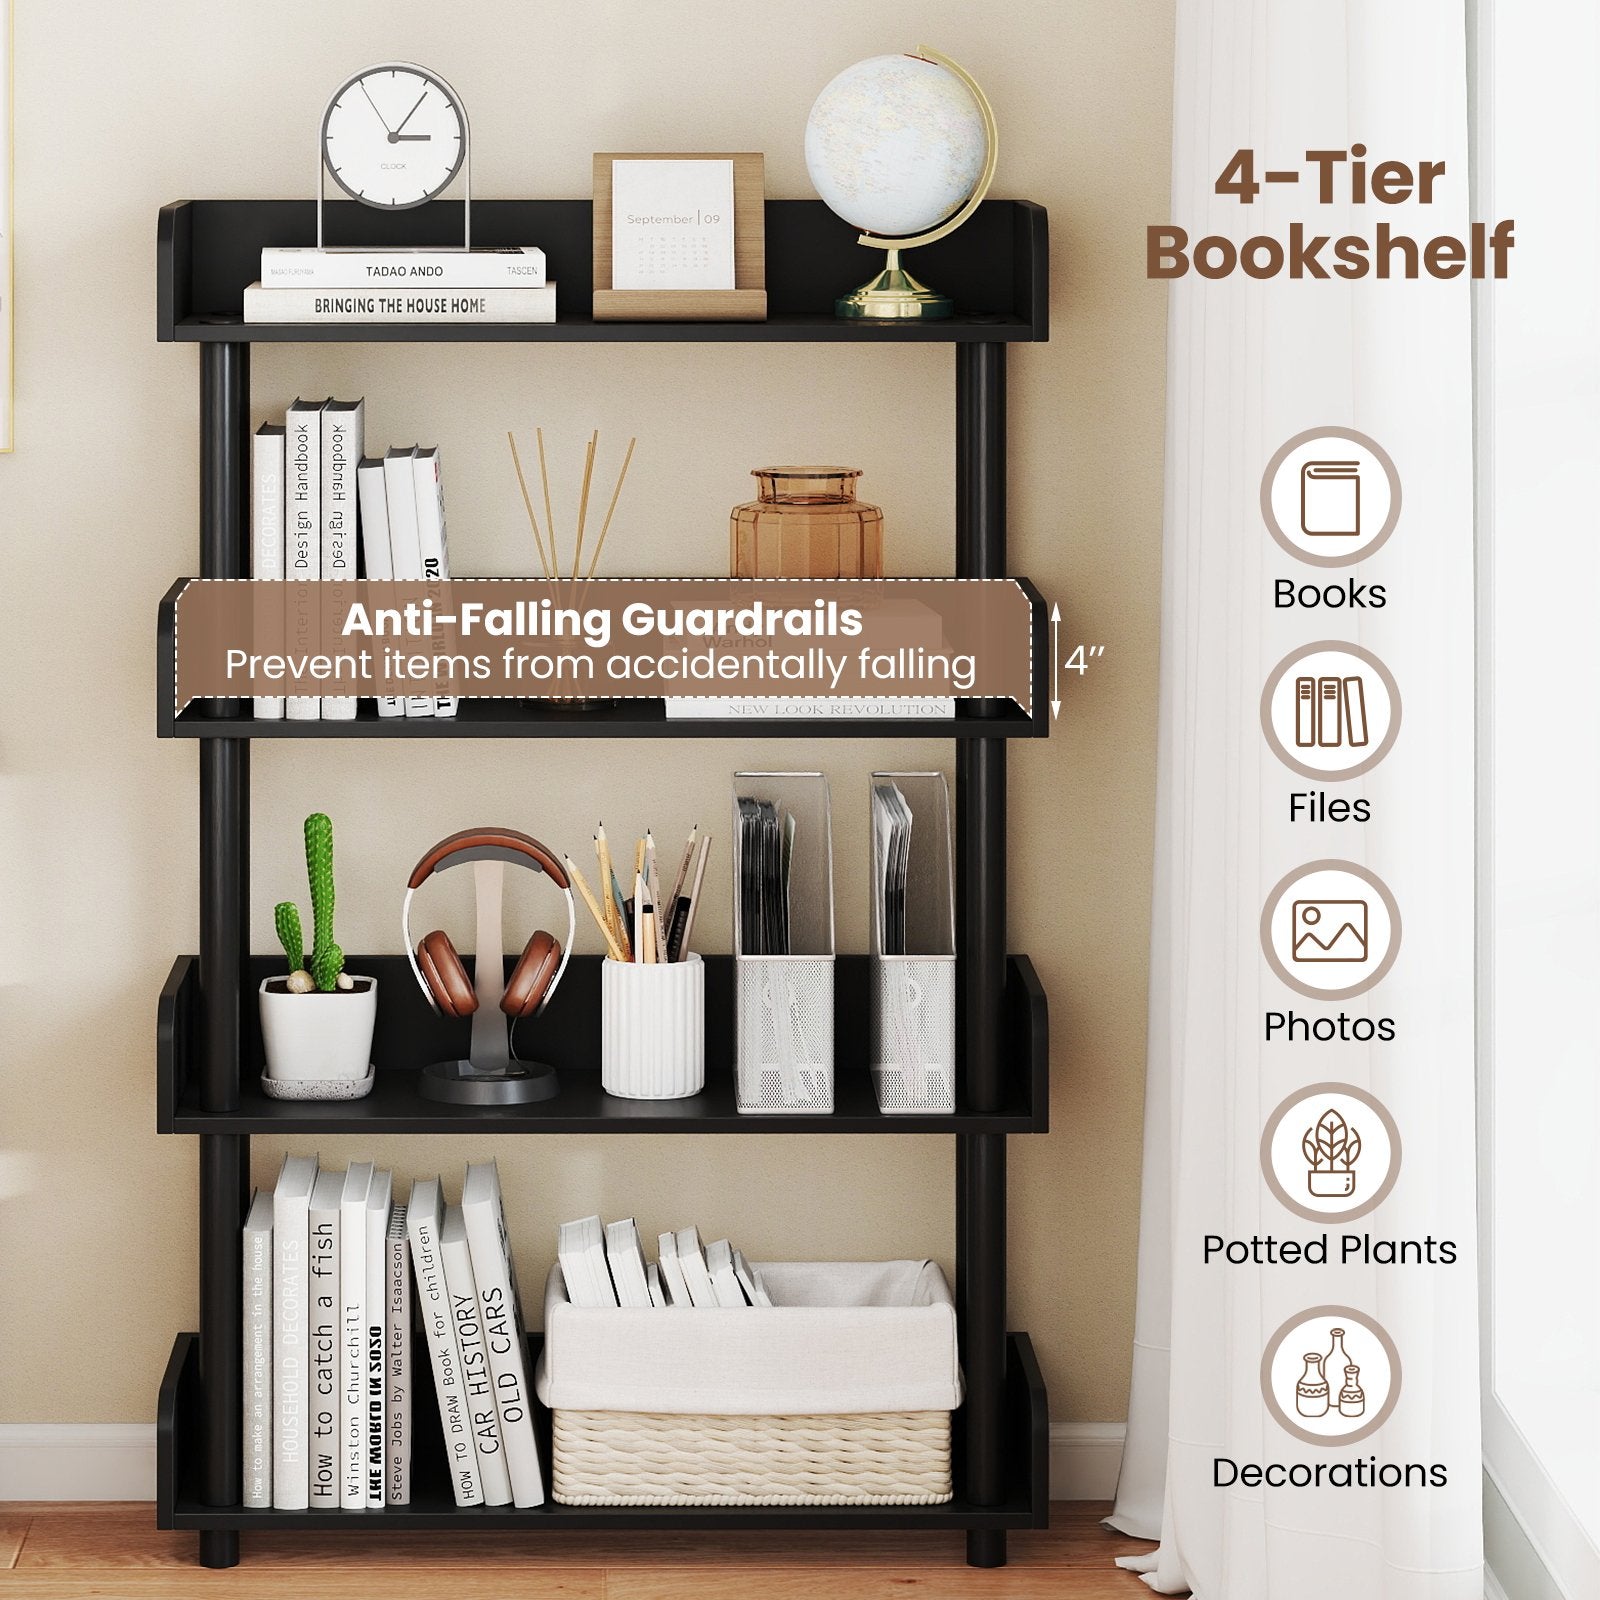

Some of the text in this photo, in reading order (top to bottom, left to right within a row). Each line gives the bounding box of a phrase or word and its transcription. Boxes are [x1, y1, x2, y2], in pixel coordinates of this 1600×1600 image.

[365, 266, 444, 277] TADAO ANDO
[626, 214, 721, 226] September 09
[314, 298, 486, 314] BRINGING THE HOUSE HOME
[294, 424, 309, 501] Handbook
[261, 473, 277, 569] DECORATES
[294, 511, 312, 569] Design
[424, 558, 441, 598] 2020
[728, 704, 947, 715] NEW LOOK REVOLUTION
[252, 1236, 265, 1499] How to make an arrangement in the house
[282, 1239, 299, 1464] HOUSEHOLD DECORATES
[312, 1223, 333, 1498] How to catch a fish
[346, 1304, 360, 1497] Winston Churchill
[390, 1243, 405, 1501] Steve Jobs by Walter Isaacson
[418, 1225, 475, 1500] HOW TO DRAW Book for children
[453, 1294, 500, 1455] CAR HISTORY
[482, 1287, 524, 1423] OLD CARS
